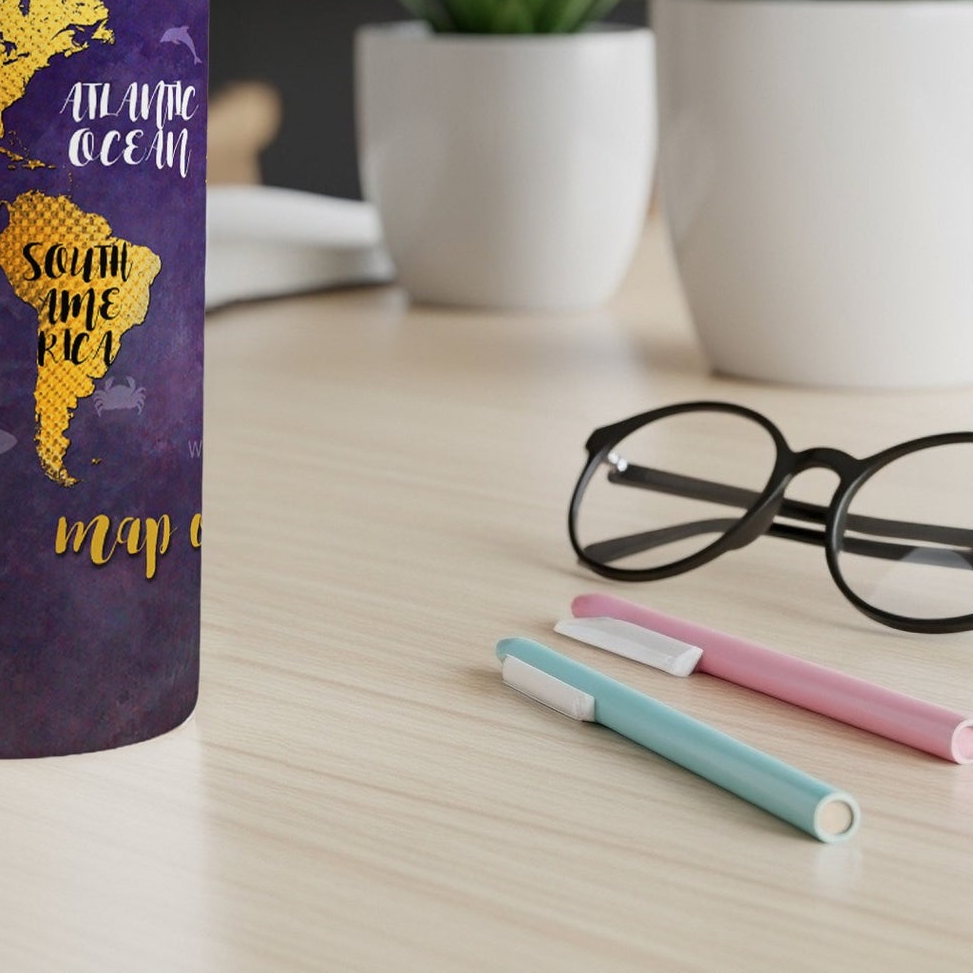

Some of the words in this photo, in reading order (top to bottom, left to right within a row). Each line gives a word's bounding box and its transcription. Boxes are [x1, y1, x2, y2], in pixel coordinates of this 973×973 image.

[60, 80, 199, 130] ATLANTIC
[68, 127, 192, 178] OCEAN
[22, 241, 134, 283] SOUTH
[39, 286, 122, 330] AME
[37, 328, 117, 368] RICA
[55, 513, 178, 579] map
